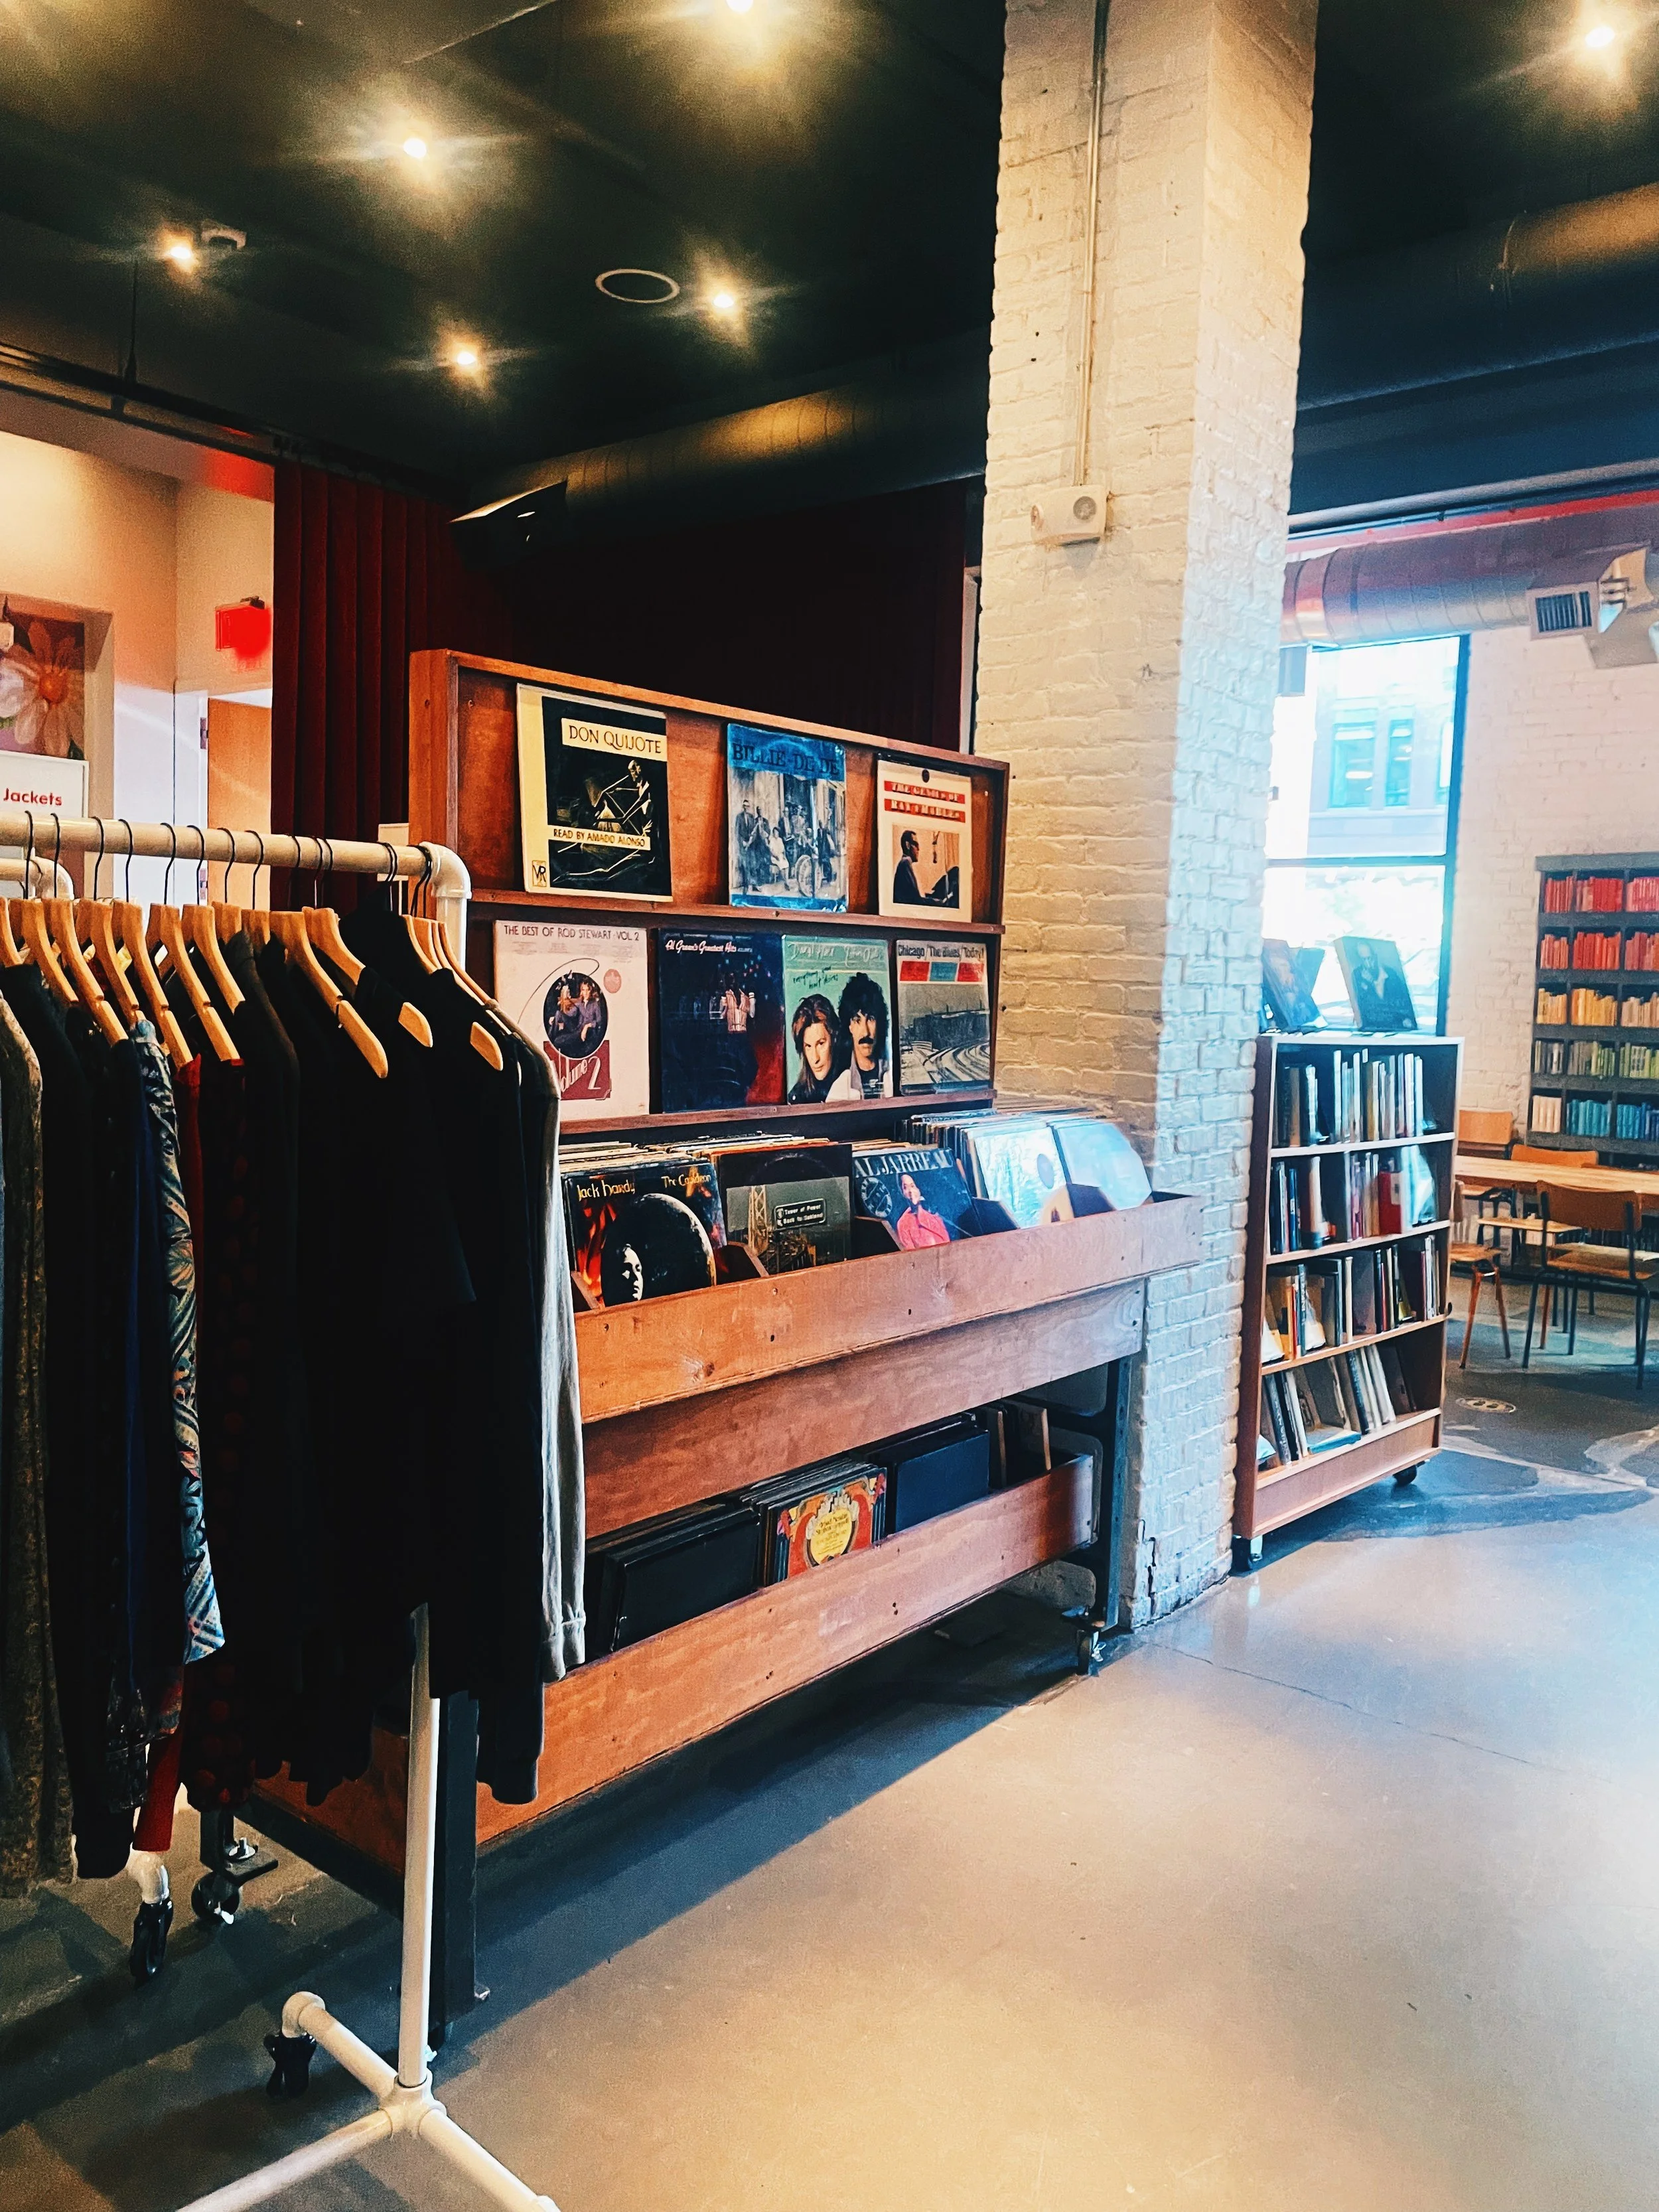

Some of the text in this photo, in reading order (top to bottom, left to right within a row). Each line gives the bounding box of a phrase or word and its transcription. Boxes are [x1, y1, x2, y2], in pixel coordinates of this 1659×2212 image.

[569, 725, 662, 754] DON QUIJOTE
[733, 743, 786, 767] BILLIE
[820, 757, 839, 776] DE
[3, 788, 62, 806] Jackets
[553, 828, 645, 847] READ BY AMADO ALONSO
[504, 924, 518, 936] THE
[522, 926, 538, 936] BEST
[542, 926, 554, 936] OF
[558, 928, 575, 938] ROD
[579, 929, 611, 940] STEWART
[634, 932, 640, 941] 2
[587, 1056, 601, 1090] 2
[854, 1148, 954, 1179] AL JARREAU
[660, 1175, 677, 1189] The
[576, 1183, 599, 1202] Jack
